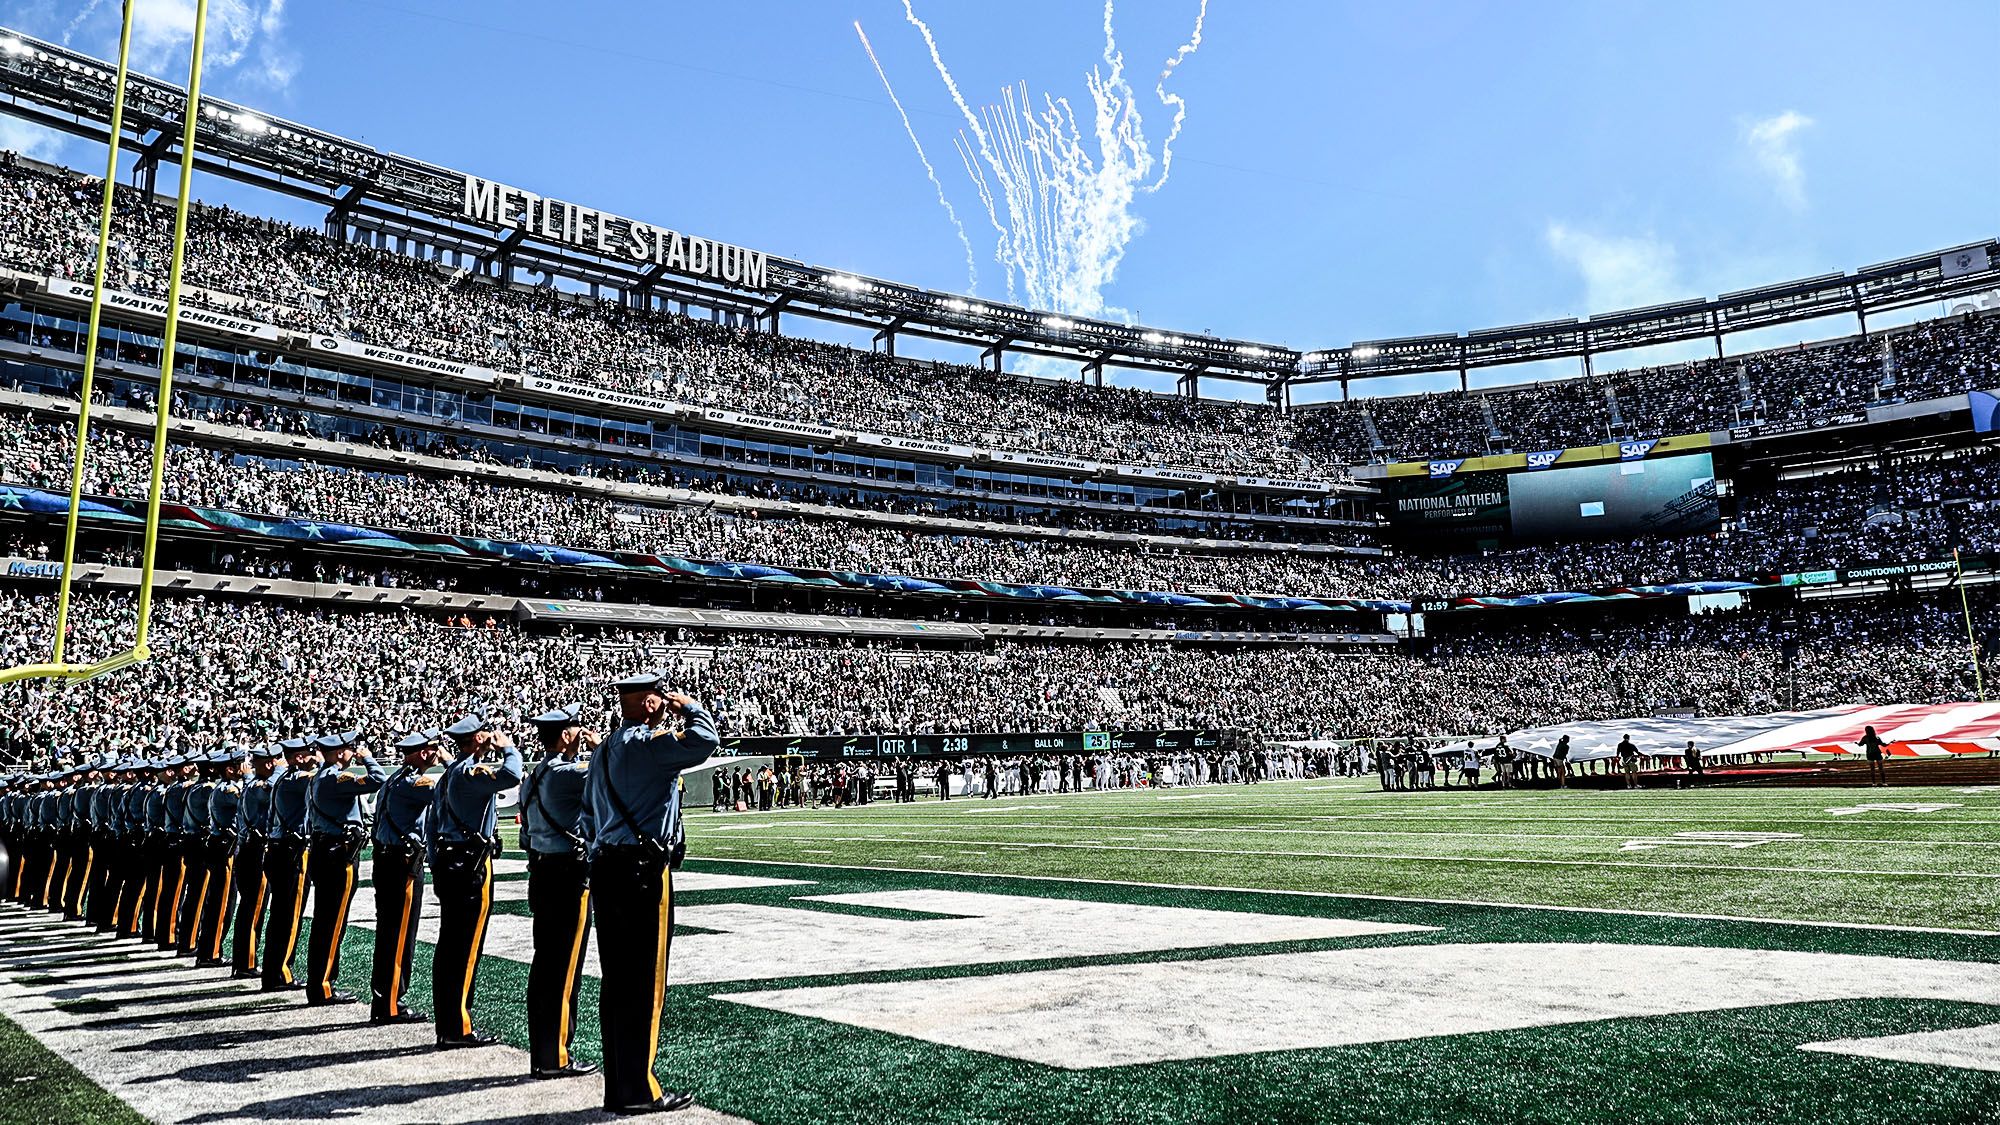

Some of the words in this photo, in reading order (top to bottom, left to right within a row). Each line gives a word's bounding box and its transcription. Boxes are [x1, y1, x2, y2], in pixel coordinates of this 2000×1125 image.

[464, 174, 618, 253] METLIFE
[629, 221, 767, 289] STADIUM
[69, 285, 94, 298] 80
[178, 309, 261, 334] CHREBET
[364, 347, 404, 363] WEEB
[405, 357, 465, 375] EWBANK
[534, 380, 553, 390] 99
[557, 384, 595, 399] MARK
[597, 392, 666, 410] GASTINEAU
[736, 416, 771, 427] LARRY
[772, 422, 832, 436] GRANTHAM
[898, 440, 925, 450] LEON
[925, 443, 950, 453] HESS
[1620, 443, 1650, 459] SAP
[1026, 456, 1066, 467] WINSTON
[1528, 453, 1556, 467] SAP
[1430, 463, 1457, 475] SAP
[1172, 472, 1203, 480] KLECKO
[1268, 480, 1297, 488] MARTY
[1398, 496, 1453, 511] NATIONAL
[1455, 492, 1502, 507] ANTHEM
[1424, 508, 1466, 519] PERFORMED
[10, 561, 64, 577] MetLif
[1847, 567, 1904, 578] COUNTDOWN
[1906, 565, 1918, 573] TO
[1919, 560, 1958, 572] KICKOFF
[566, 605, 613, 614] MetLife
[1421, 601, 1449, 611] 12:59
[720, 614, 775, 624] METLIFE
[775, 617, 824, 627] STADIUM
[882, 739, 906, 754] QTR
[911, 738, 918, 753] 1
[942, 737, 969, 752] 2:38
[1002, 739, 1009, 750] &
[1034, 738, 1052, 748] BALL
[1053, 738, 1064, 748] ON
[1091, 735, 1103, 747] 25
[1112, 739, 1122, 749] EY
[1155, 738, 1165, 748] EY
[1194, 737, 1203, 746] EY
[786, 747, 799, 756] EY
[843, 745, 855, 756] EY
